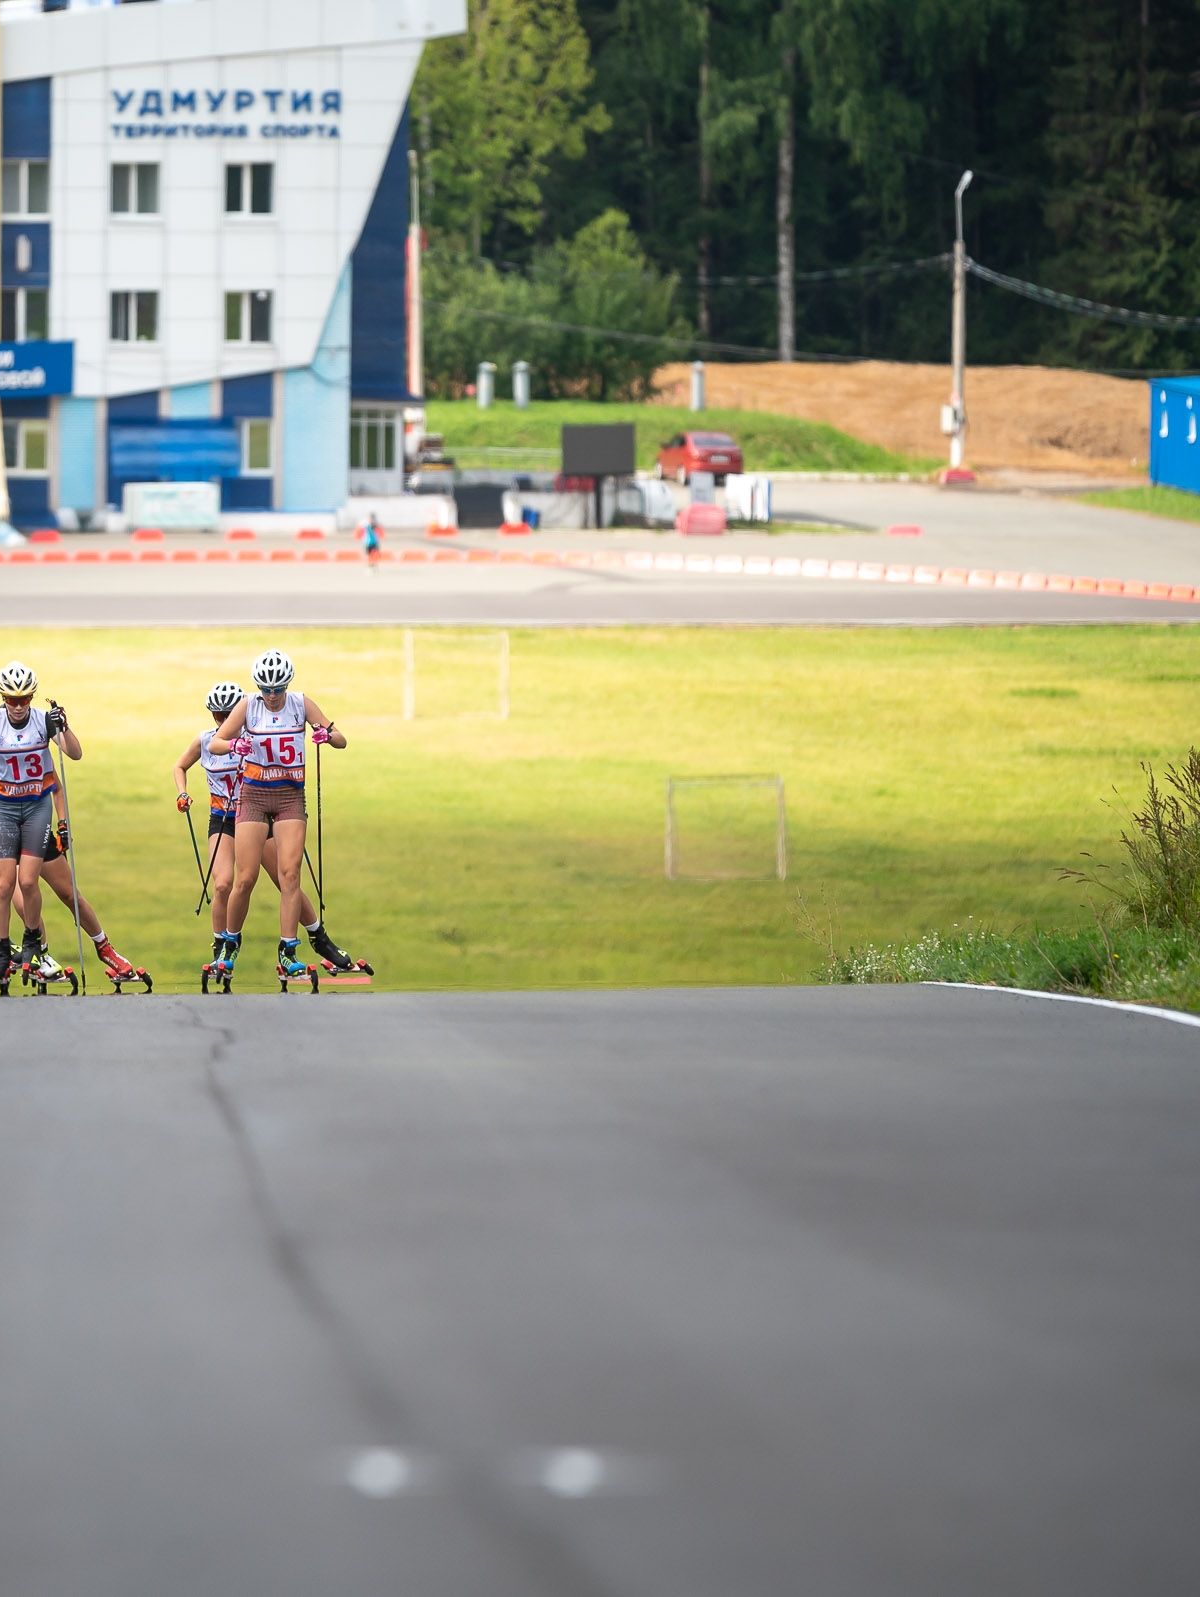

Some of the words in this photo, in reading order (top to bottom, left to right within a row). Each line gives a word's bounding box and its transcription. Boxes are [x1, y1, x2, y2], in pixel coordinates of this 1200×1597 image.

[111, 89, 342, 117] УДМУРТИЯ
[111, 123, 249, 139] ТЕРРИТОРИЯ
[259, 123, 341, 139] СПОРТА
[259, 736, 296, 765] 15
[6, 753, 43, 781] 13
[4, 783, 43, 796] УДМУРТ
